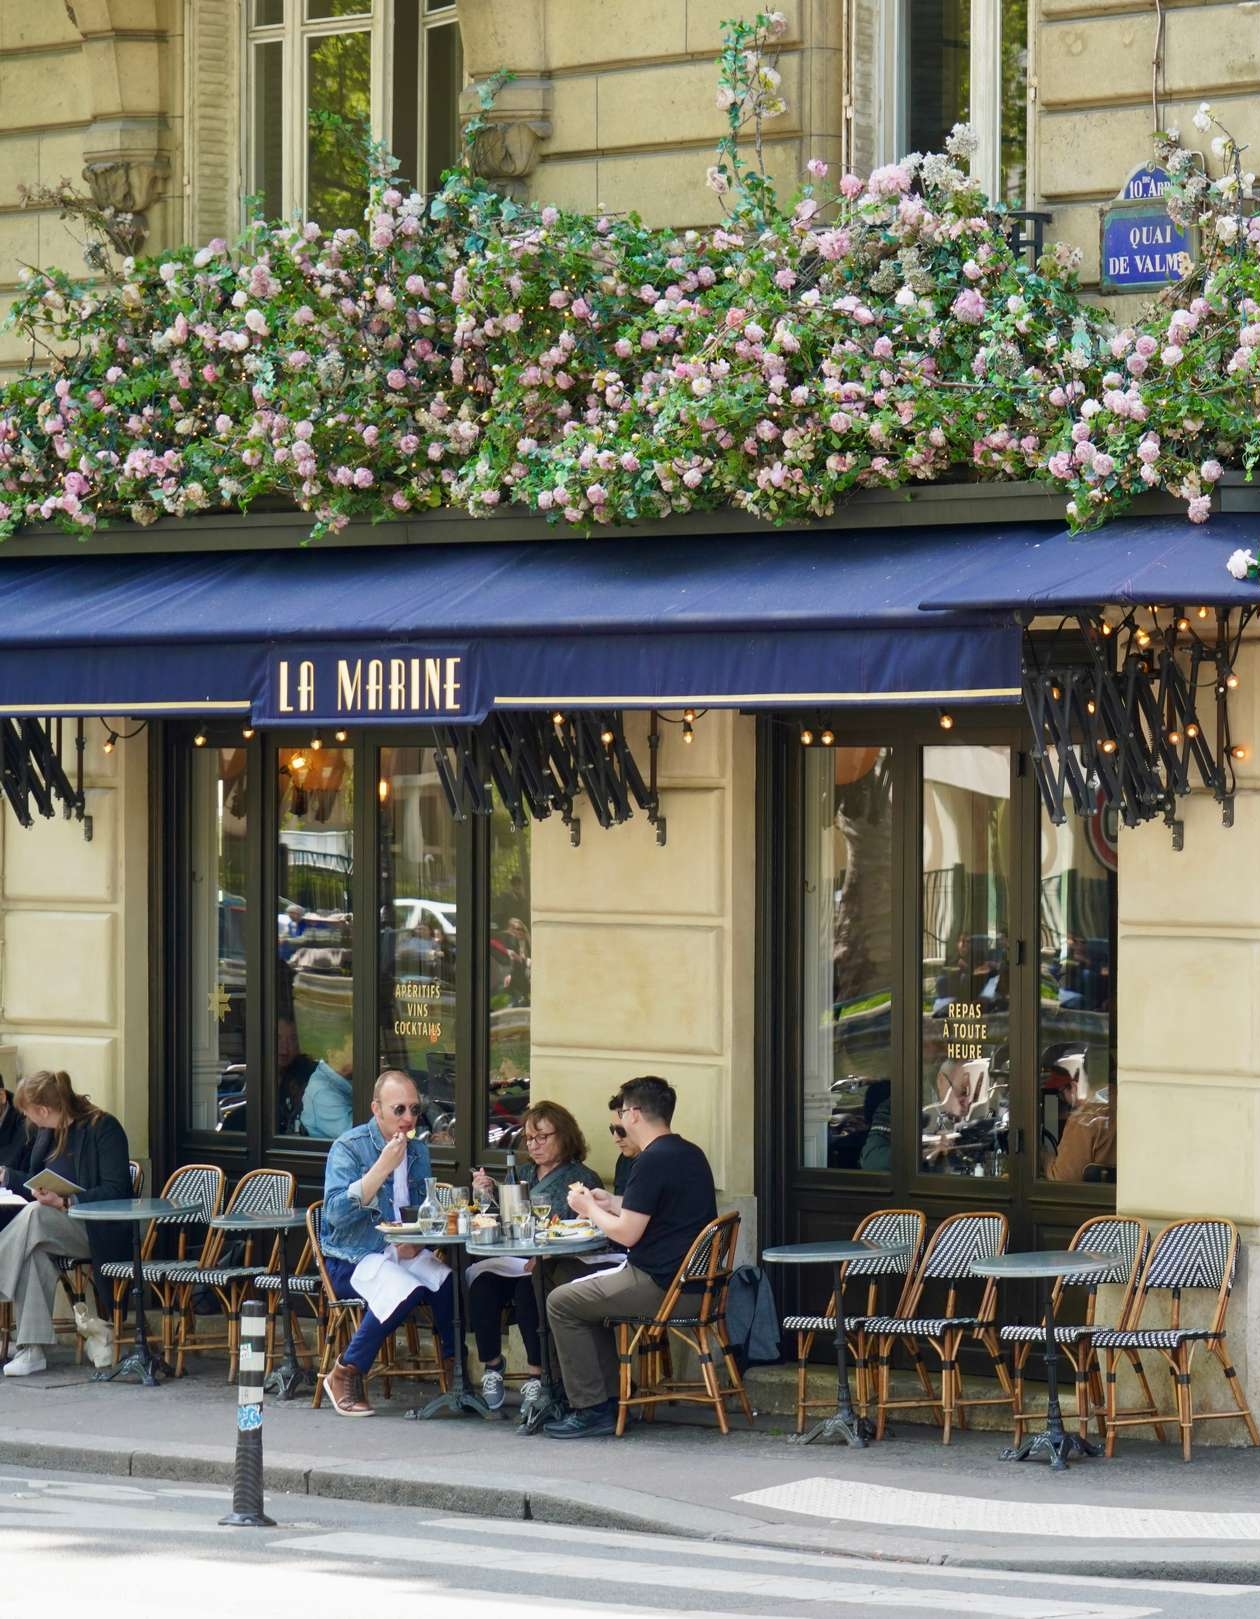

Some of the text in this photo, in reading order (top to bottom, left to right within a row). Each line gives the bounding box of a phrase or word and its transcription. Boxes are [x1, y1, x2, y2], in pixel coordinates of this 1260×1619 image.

[1129, 225, 1172, 248] QUAI
[1109, 253, 1180, 275] DE VALM
[279, 657, 461, 712] LA MARINE
[395, 980, 440, 999] APÉRITIFS
[407, 1003, 428, 1017] VINS
[949, 1003, 982, 1018] REPAS
[394, 1021, 441, 1037] COCKTAILS
[943, 1018, 987, 1039] À TOUTE
[947, 1043, 982, 1059] HEURE
